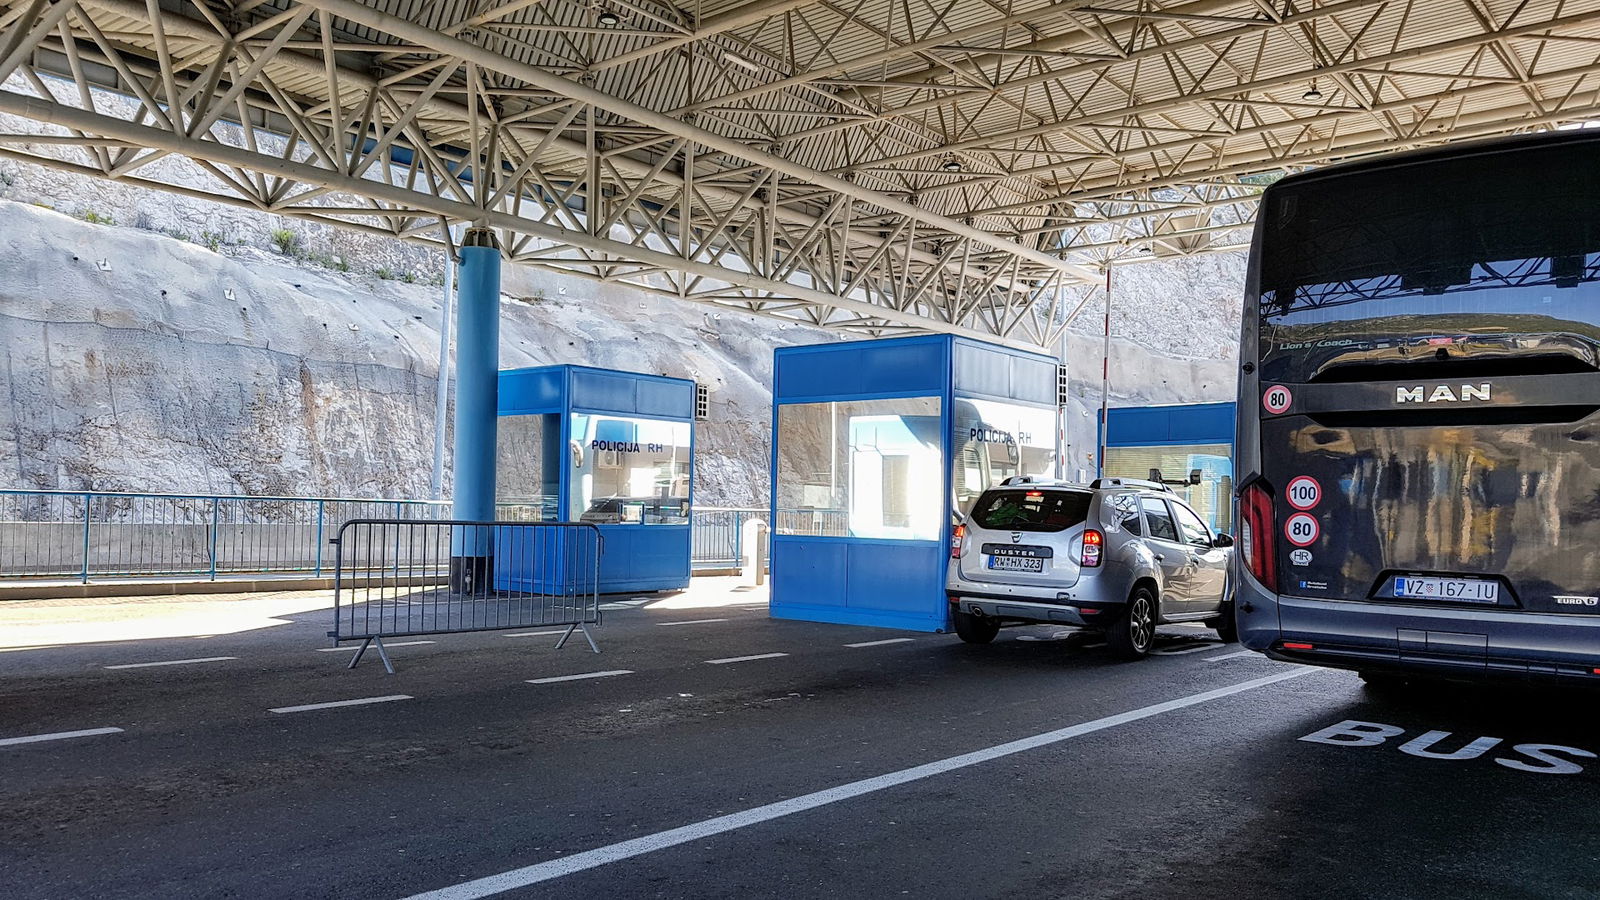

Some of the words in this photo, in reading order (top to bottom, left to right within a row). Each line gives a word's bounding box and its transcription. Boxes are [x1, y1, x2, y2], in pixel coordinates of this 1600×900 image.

[1316, 339, 1353, 347] Coach
[1270, 392, 1285, 406] 80
[1396, 383, 1491, 403] MAN
[970, 428, 1012, 444] POLICIJA
[1018, 432, 1032, 444] RH
[591, 440, 640, 453] POLICIJA
[647, 443, 663, 453] RH
[1291, 486, 1316, 500] 100
[1292, 522, 1311, 536] 80
[1294, 551, 1309, 561] HR
[1010, 559, 1023, 568] HX
[1024, 559, 1041, 569] 323
[1406, 580, 1425, 595] VZ
[1557, 597, 1583, 605] EURO
[1297, 719, 1598, 775] BUS
